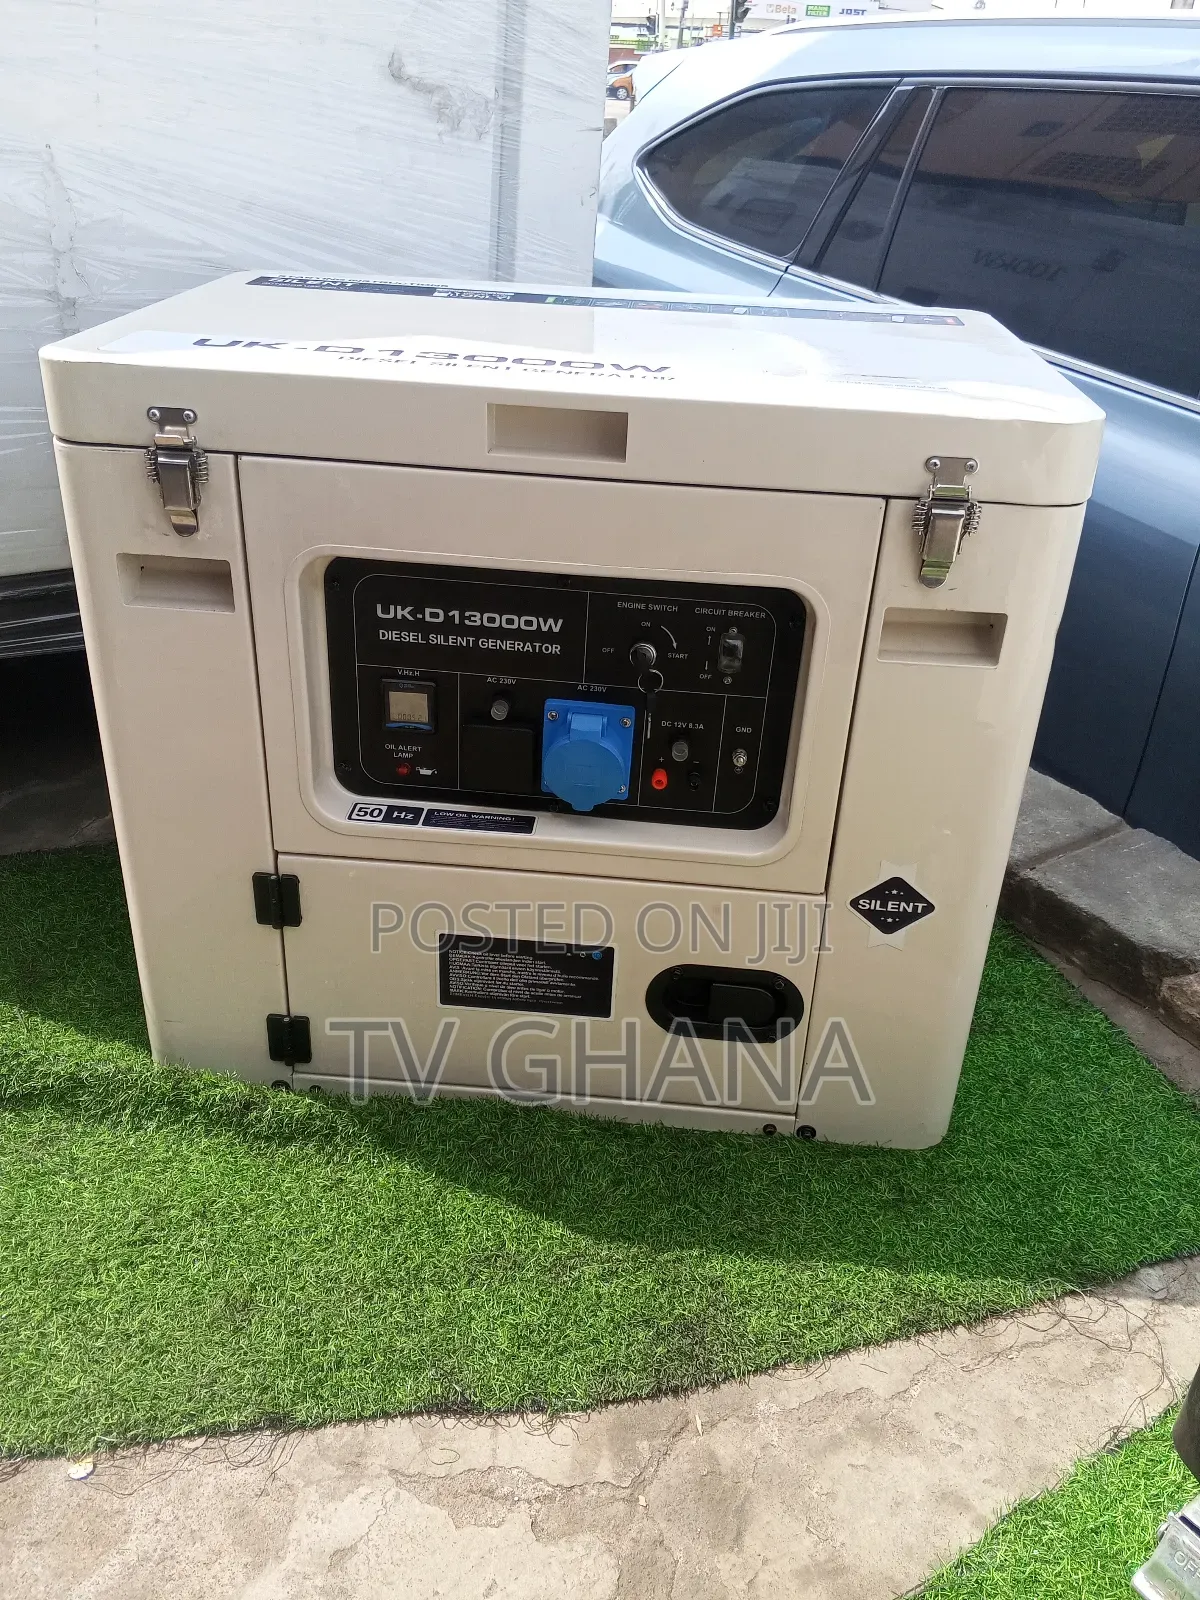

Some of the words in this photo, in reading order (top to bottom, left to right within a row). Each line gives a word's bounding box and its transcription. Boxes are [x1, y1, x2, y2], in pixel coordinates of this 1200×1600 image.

[775, 5, 797, 14] Beta
[839, 8, 867, 16] JOST
[192, 338, 672, 373] UK-D13000W
[617, 601, 646, 610] ENGINE
[648, 603, 679, 612] SWITCH
[694, 607, 727, 616] CIRCUIT
[727, 610, 766, 619] BREAKER
[376, 603, 564, 633] UK-D13000W
[378, 629, 427, 644] DIESEL
[428, 633, 475, 648] SILENT
[478, 638, 561, 655] GENERATOR
[667, 652, 689, 660] START
[486, 676, 498, 684] AC
[499, 677, 517, 685] 230V
[577, 684, 588, 692] AC
[589, 685, 607, 693] 230V
[661, 720, 672, 728] DC
[673, 721, 687, 729] 12V
[735, 726, 752, 734] GND
[384, 743, 397, 751] OIL
[398, 744, 422, 752] ALERT
[355, 806, 384, 818] 50
[392, 810, 415, 820] Hz
[471, 814, 515, 822] WARNING!
[857, 899, 928, 914] SILENT
